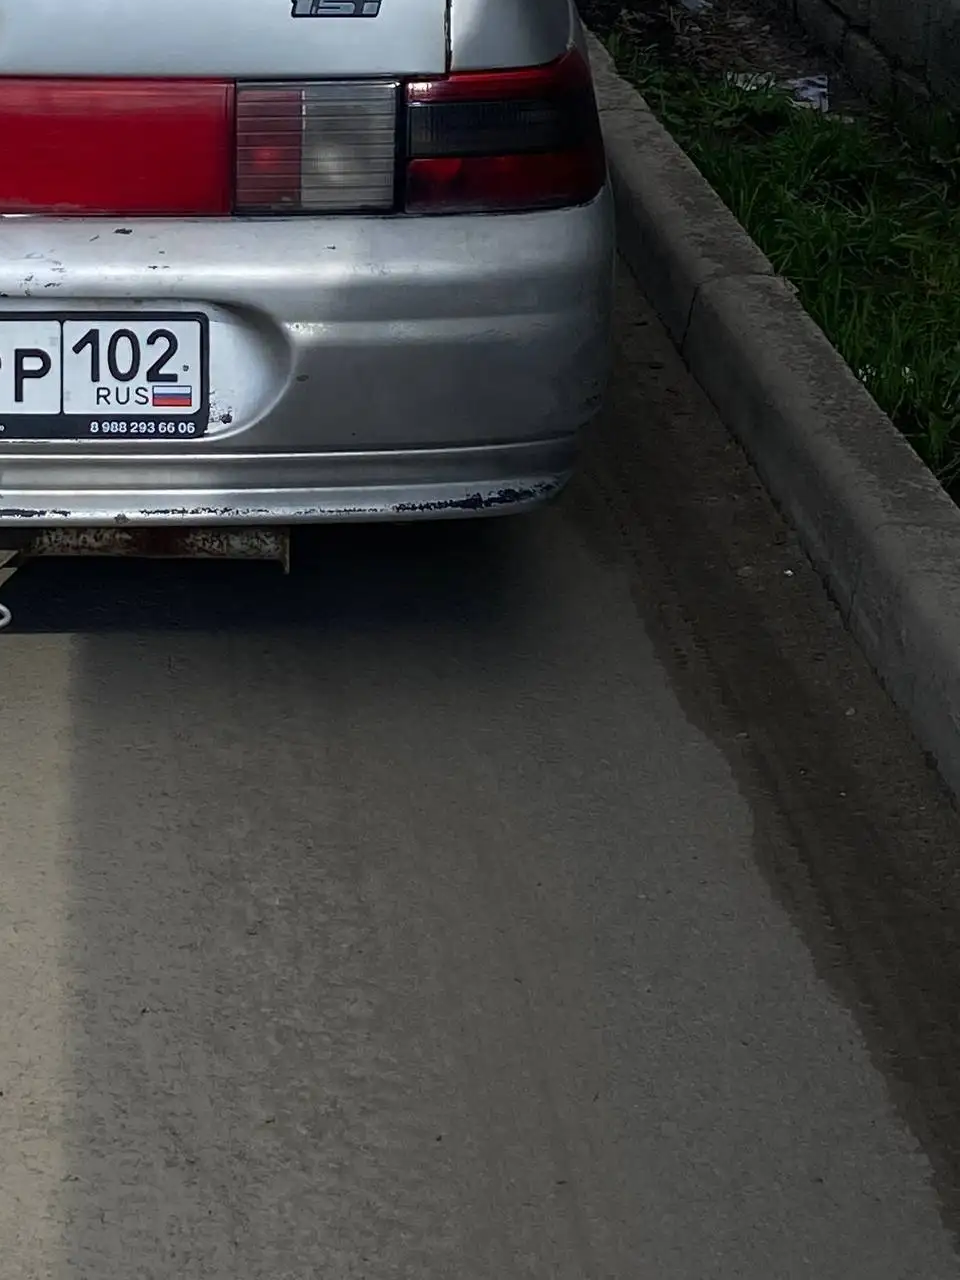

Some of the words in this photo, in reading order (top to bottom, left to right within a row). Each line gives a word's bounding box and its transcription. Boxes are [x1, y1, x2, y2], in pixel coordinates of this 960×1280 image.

[72, 328, 178, 383] 102
[96, 386, 149, 406] RUS
[90, 422, 99, 433] 8
[102, 422, 127, 433] 988
[130, 422, 155, 434] 293
[158, 422, 175, 434] 66
[178, 422, 195, 434] 06
